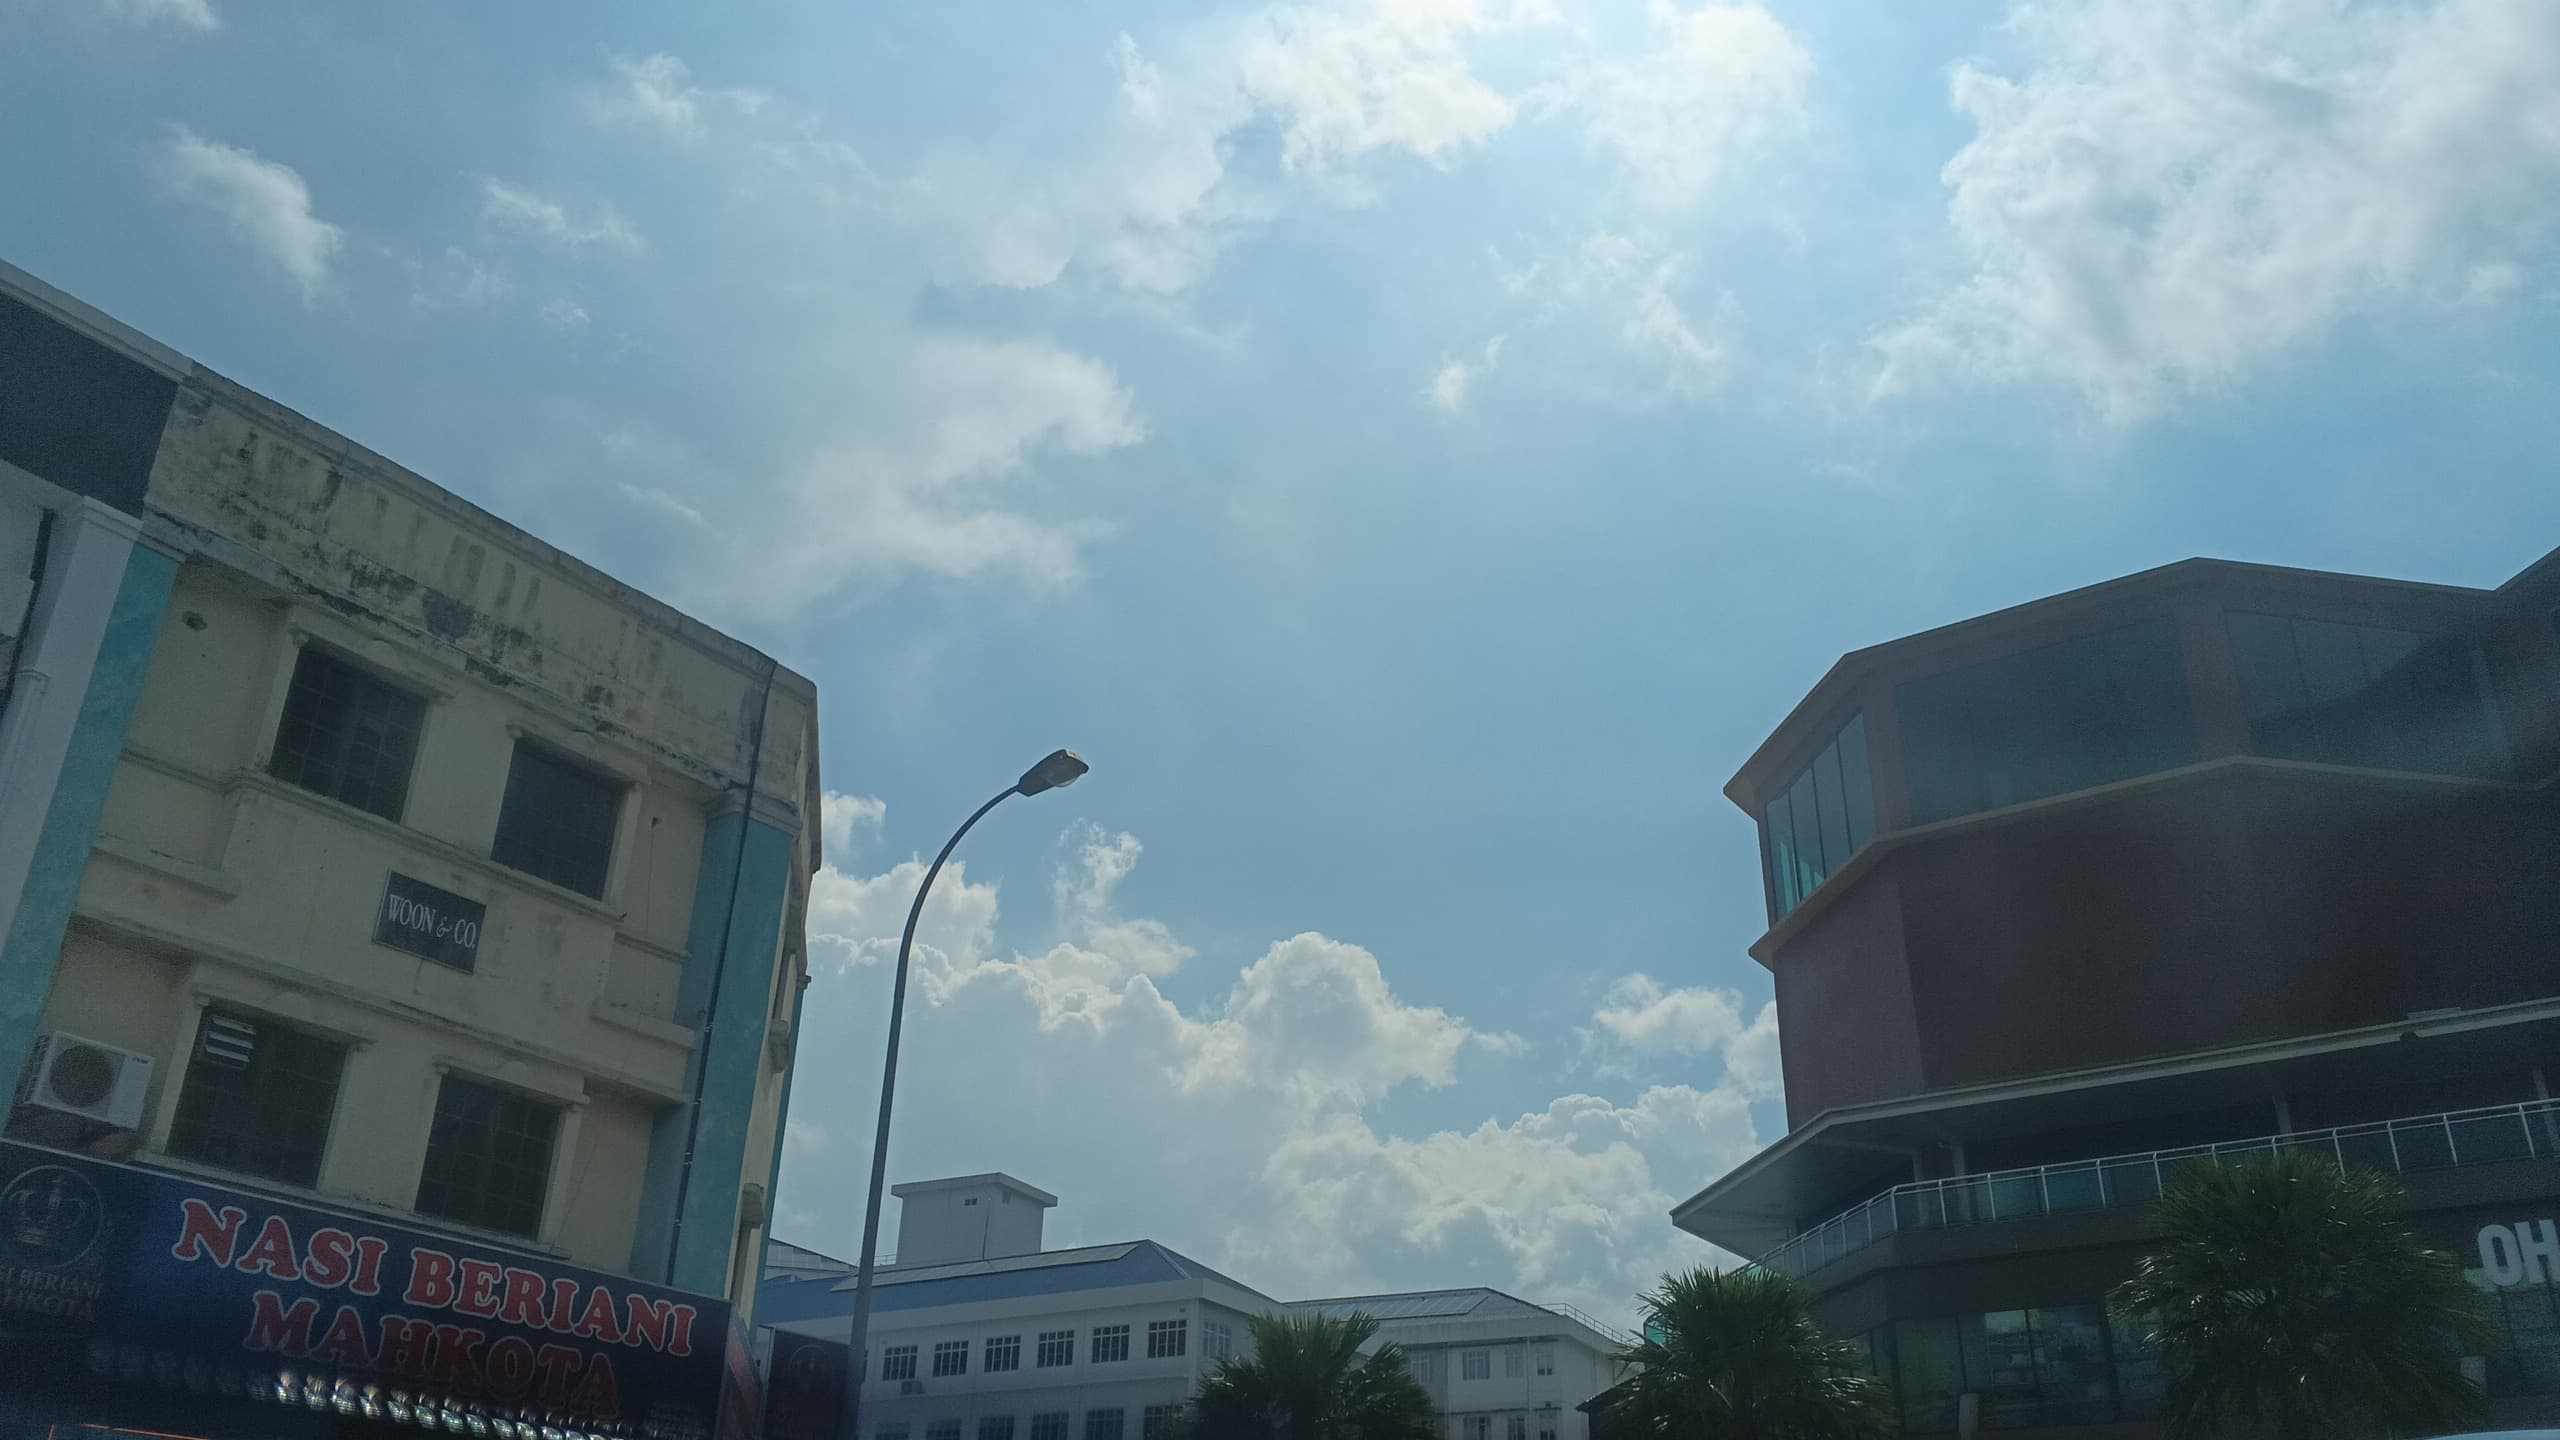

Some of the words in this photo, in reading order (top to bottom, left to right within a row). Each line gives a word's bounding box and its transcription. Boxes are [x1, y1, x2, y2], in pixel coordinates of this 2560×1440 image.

[388, 893, 436, 934] WOON
[436, 916, 453, 937] &
[454, 918, 476, 949] CO.
[172, 1198, 388, 1296] NASI
[402, 1247, 696, 1357] BERIANI
[2477, 1218, 2560, 1287] OH
[243, 1290, 619, 1418] MAHKOTA
